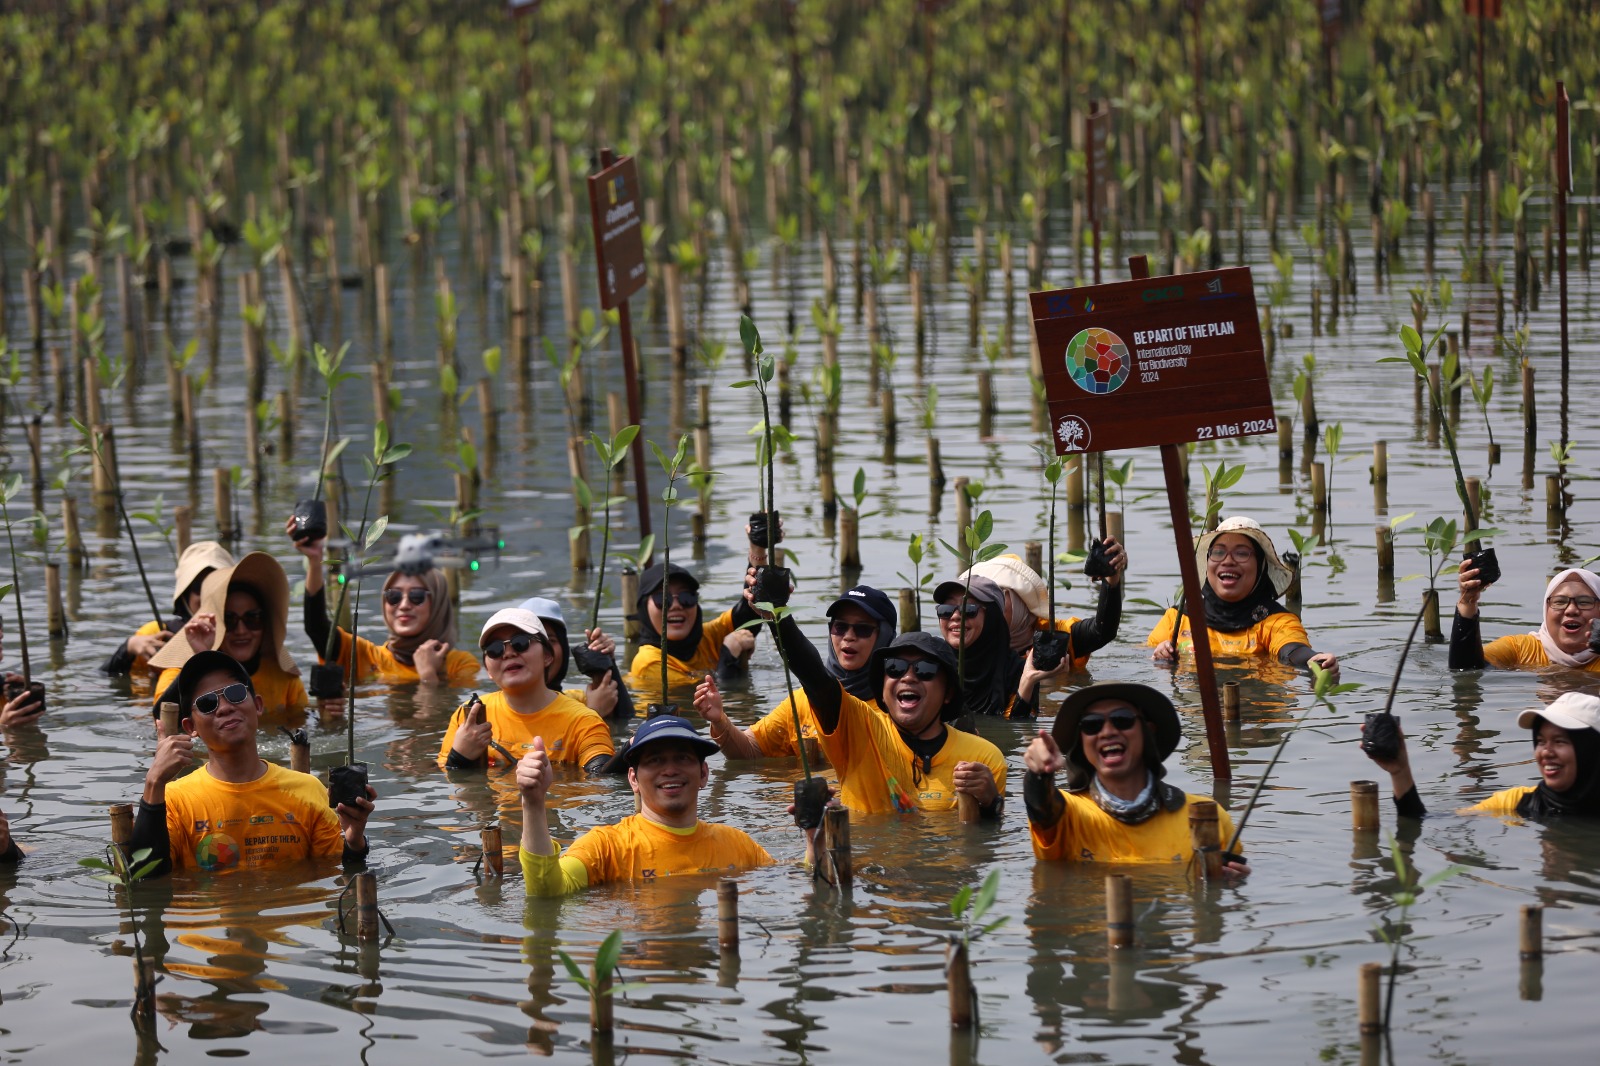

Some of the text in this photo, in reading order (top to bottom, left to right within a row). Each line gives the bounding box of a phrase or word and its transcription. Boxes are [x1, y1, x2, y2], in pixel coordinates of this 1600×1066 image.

[1133, 321, 1235, 345] BE PART OF THE PLAN
[1136, 344, 1192, 359] International Day
[1139, 357, 1188, 371] for Biodiversity
[1140, 371, 1160, 383] 2024
[1196, 418, 1275, 440] 22 Mei 2024
[244, 837, 253, 846] BE
[253, 836, 270, 845] PART
[270, 835, 279, 844] OF
[279, 835, 290, 844] THE
